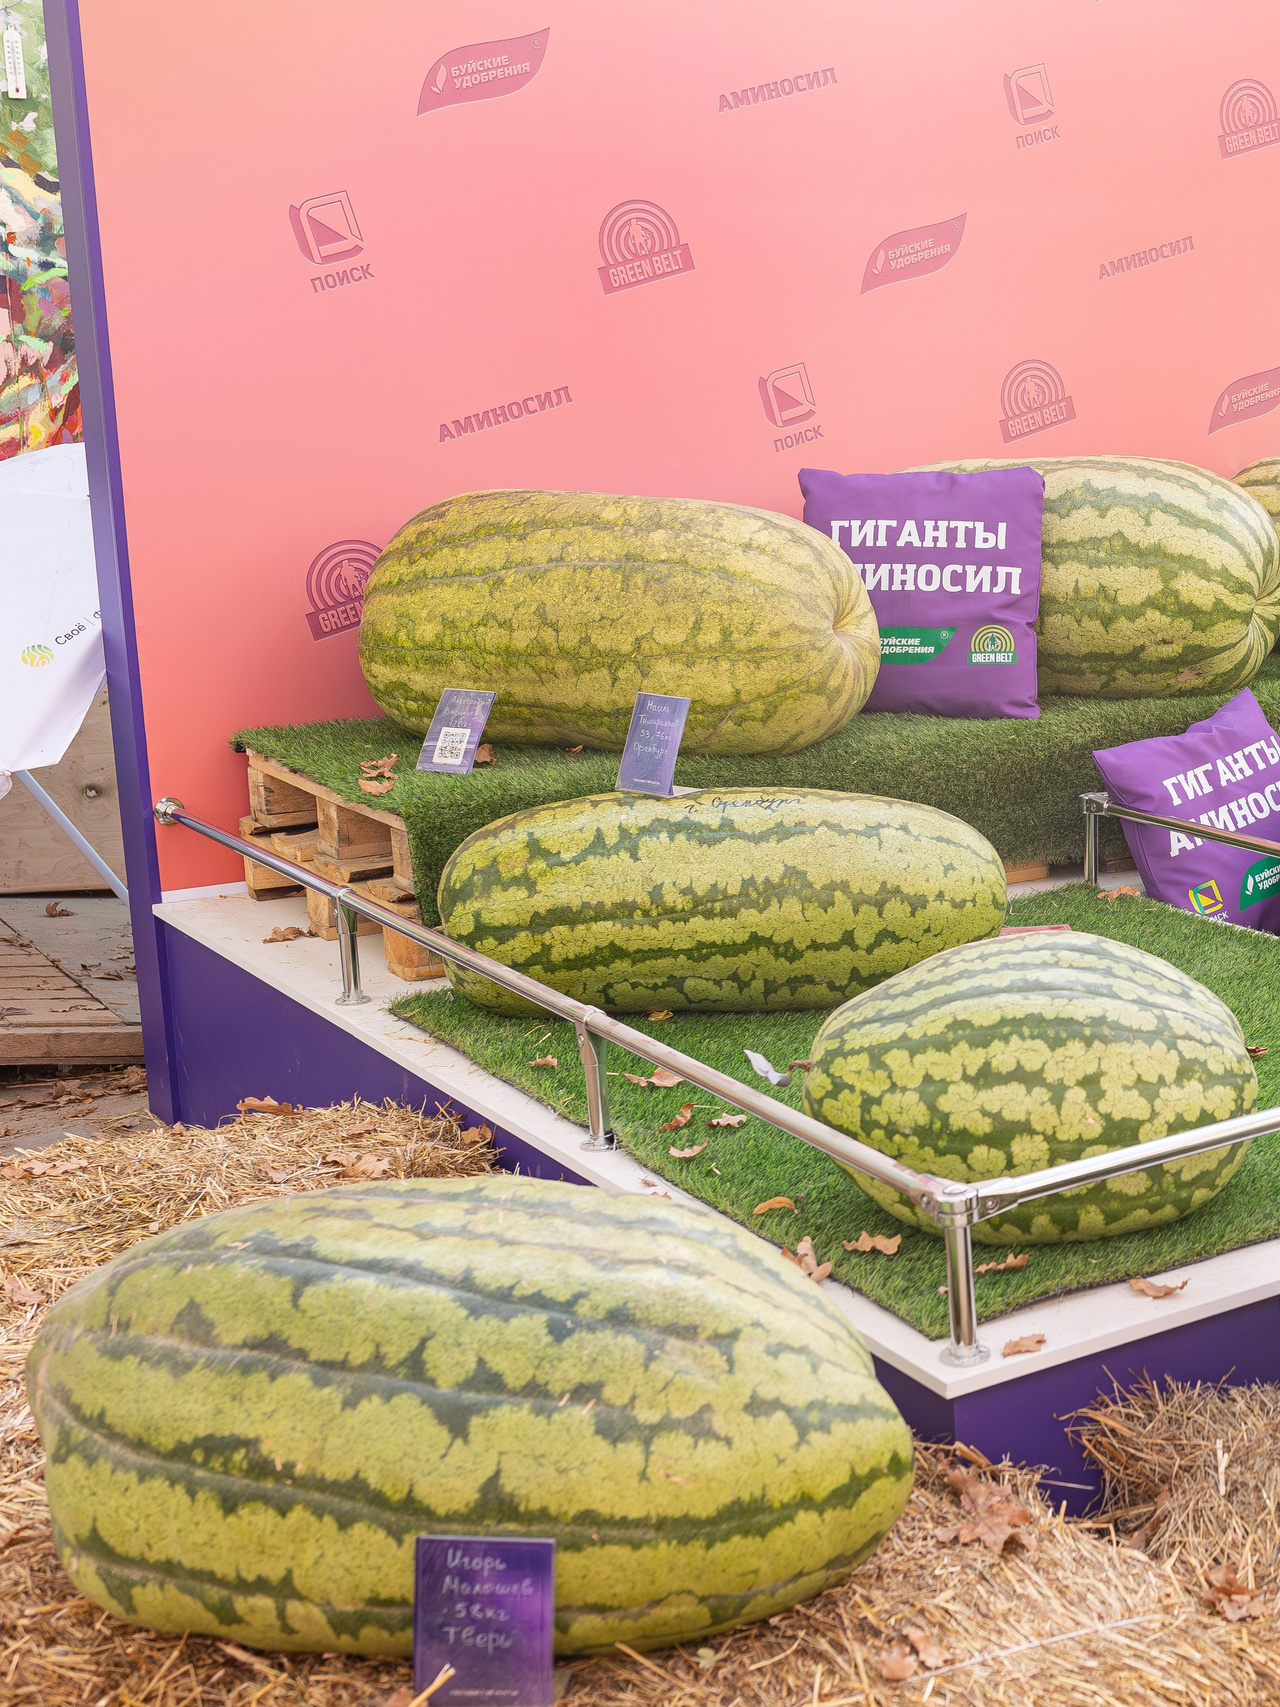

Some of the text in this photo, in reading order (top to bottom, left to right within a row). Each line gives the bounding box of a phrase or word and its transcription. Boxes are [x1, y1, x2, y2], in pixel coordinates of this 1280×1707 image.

[451, 55, 510, 78] БУЙСКИЕ
[453, 62, 531, 89] УДОБРЕНИЯ
[718, 67, 839, 113] АМИНОСИЛ
[1015, 125, 1061, 150] ПОИСК
[1225, 123, 1280, 154] GREEN BELT
[888, 238, 935, 260] БУЙСКИЕ
[890, 243, 951, 270] УДОБРЕНИЯ
[1098, 235, 1196, 280] АМИНОСИЛ
[310, 263, 375, 293] ПОИСК
[609, 249, 684, 288] GREEN BELT
[1231, 382, 1270, 404] БУЙСКИЕ
[439, 386, 573, 443] АМИНОСИЛ
[1008, 402, 1068, 438] GREEN BELT
[773, 425, 825, 453] ПОИСК
[830, 519, 1007, 550] ГИГАНТЫ
[852, 563, 1022, 595] ИНОСИЛ
[54, 622, 87, 646] Своё
[880, 646, 935, 654] ДОБРЕНИЯ
[972, 652, 1013, 663] GREEN BELT
[443, 1625, 513, 1655] Тверь
